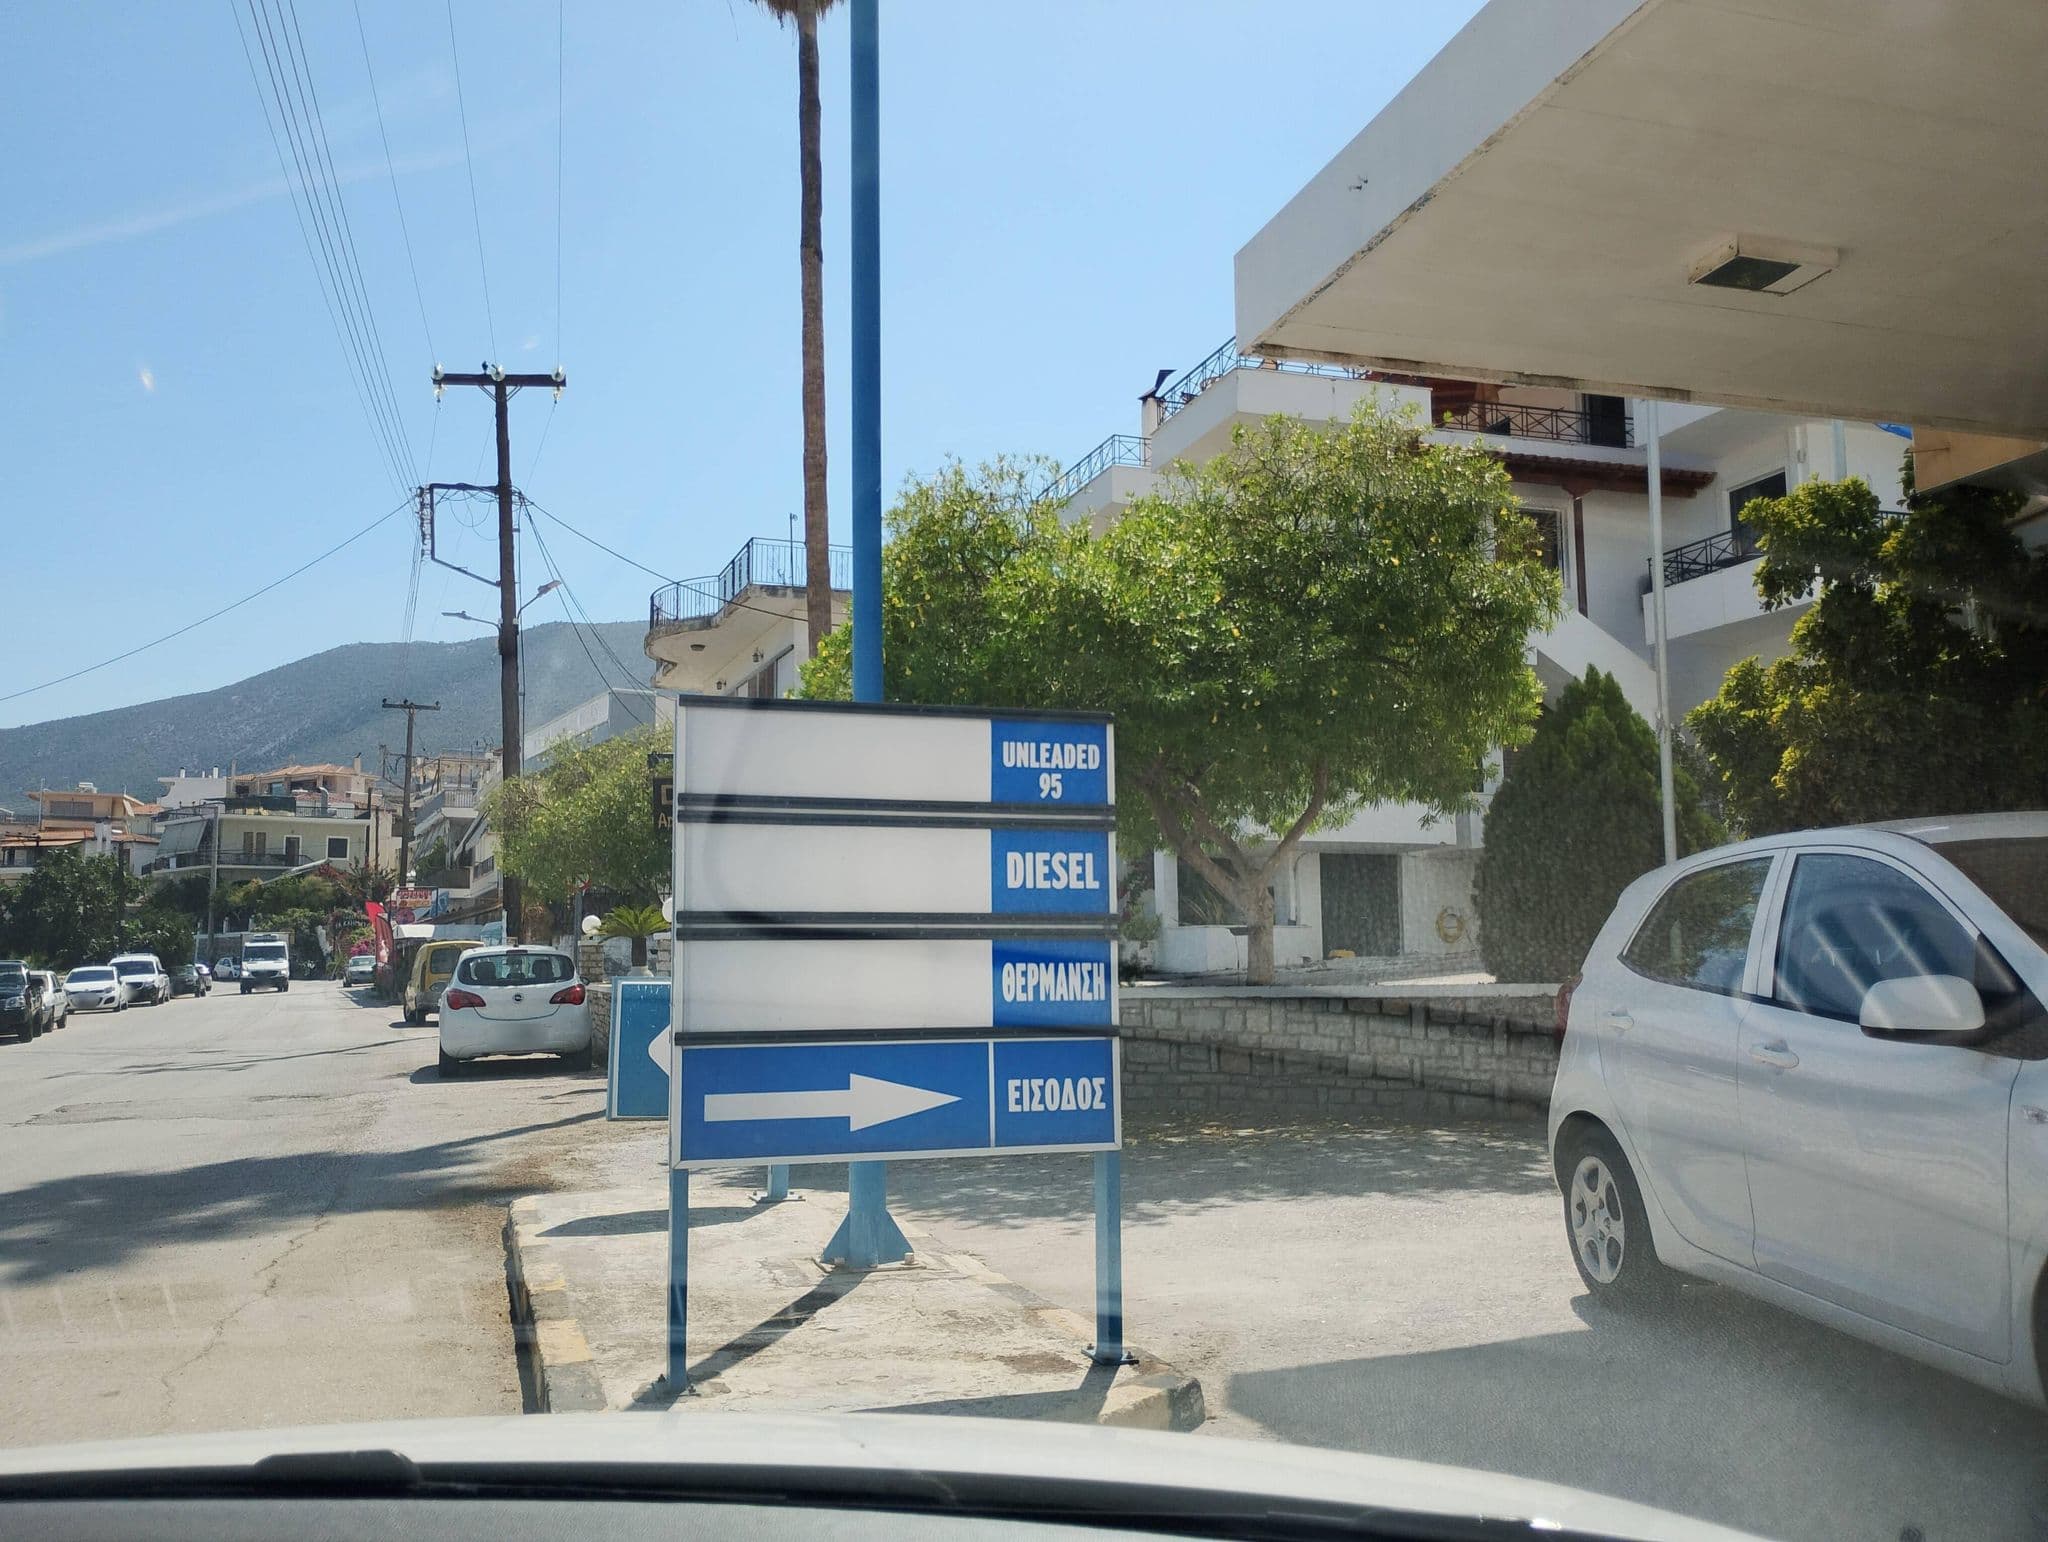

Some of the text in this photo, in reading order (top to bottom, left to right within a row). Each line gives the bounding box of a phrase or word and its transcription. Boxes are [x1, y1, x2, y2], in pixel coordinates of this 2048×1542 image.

[1002, 741, 1100, 769] UNLEADED
[1039, 772, 1063, 800] 95
[1006, 851, 1100, 889] DIESEL
[1002, 962, 1105, 1002] ΘΕΡΜΑΝΣΗ
[1007, 1077, 1106, 1112] ΕΙΣΟΔΟΣ
